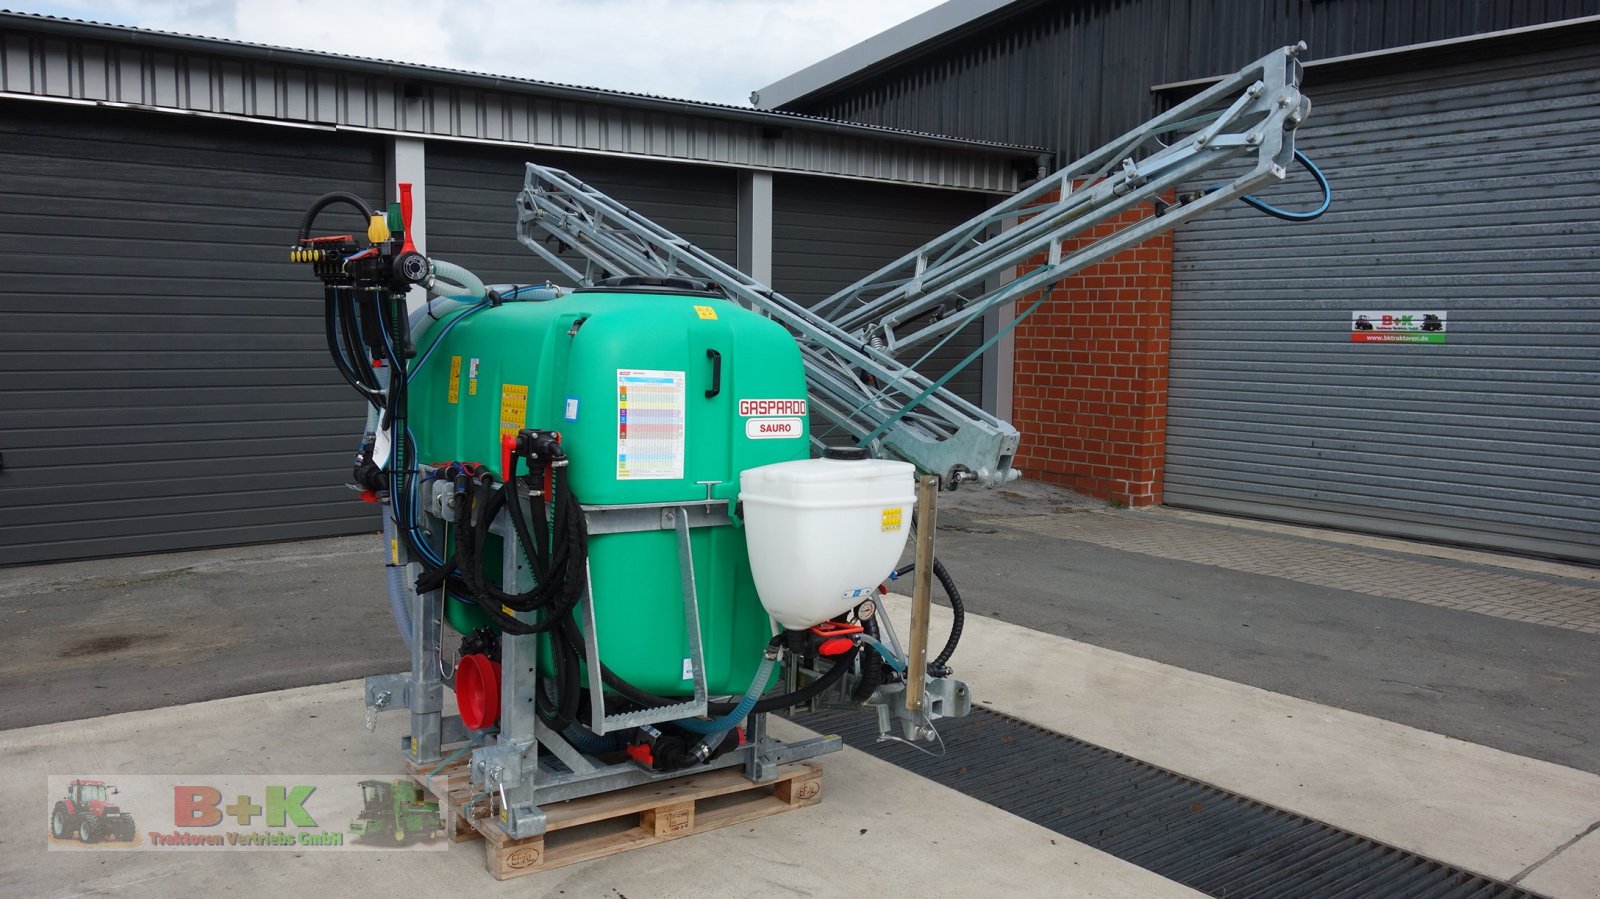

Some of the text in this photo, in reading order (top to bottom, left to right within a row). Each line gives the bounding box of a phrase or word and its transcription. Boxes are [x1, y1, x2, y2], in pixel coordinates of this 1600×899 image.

[1382, 315, 1413, 325] B+K
[1366, 334, 1429, 342] www.bktraktoren.de
[740, 400, 806, 415] GASPARDO
[760, 424, 791, 433] SAURO
